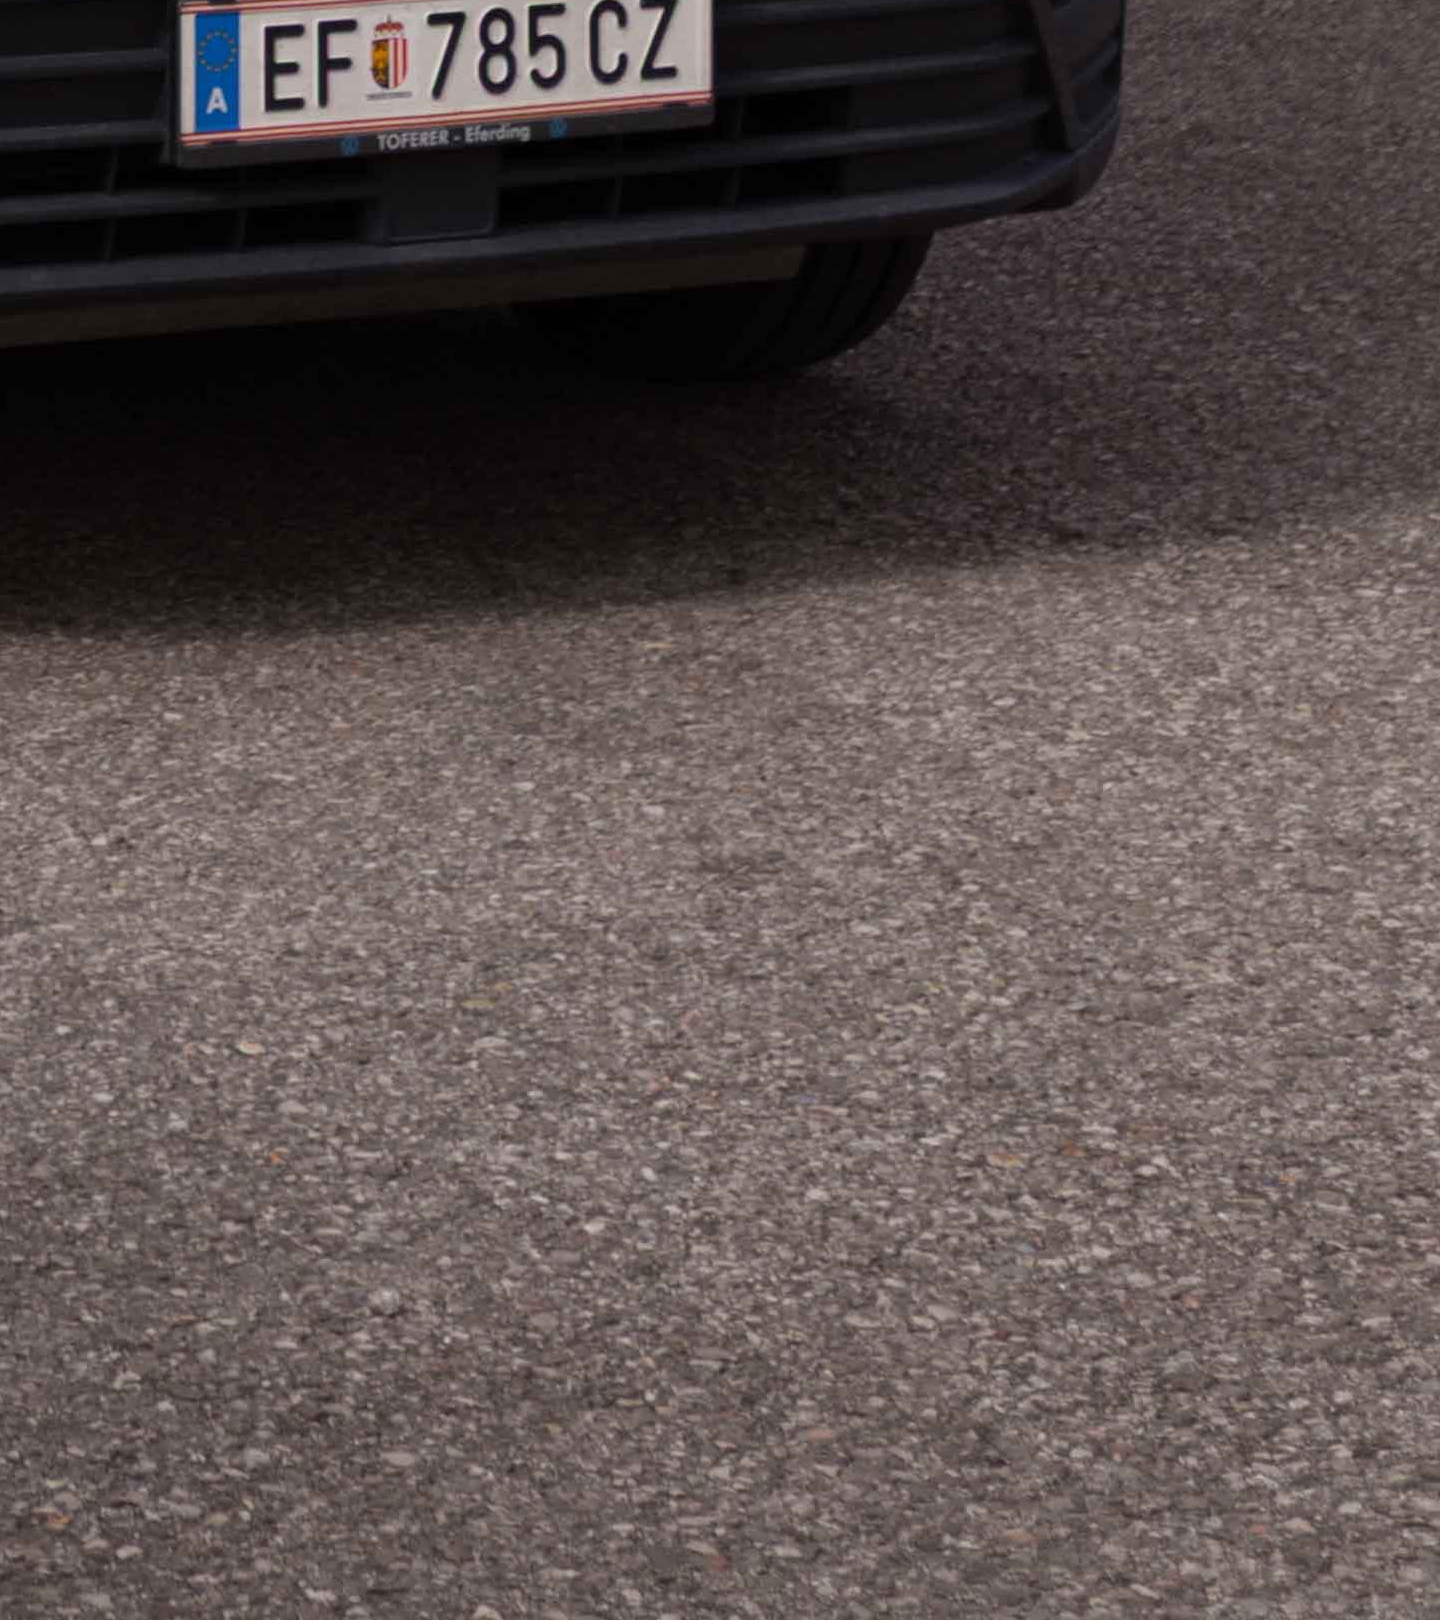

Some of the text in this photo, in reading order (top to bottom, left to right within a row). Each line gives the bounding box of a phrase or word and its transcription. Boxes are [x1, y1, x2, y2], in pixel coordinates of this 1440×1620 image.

[205, 86, 229, 115] A
[263, 19, 358, 114] EF
[426, 2, 567, 100] 785
[376, 130, 450, 152] TOFERER
[464, 124, 531, 144] Eferding
